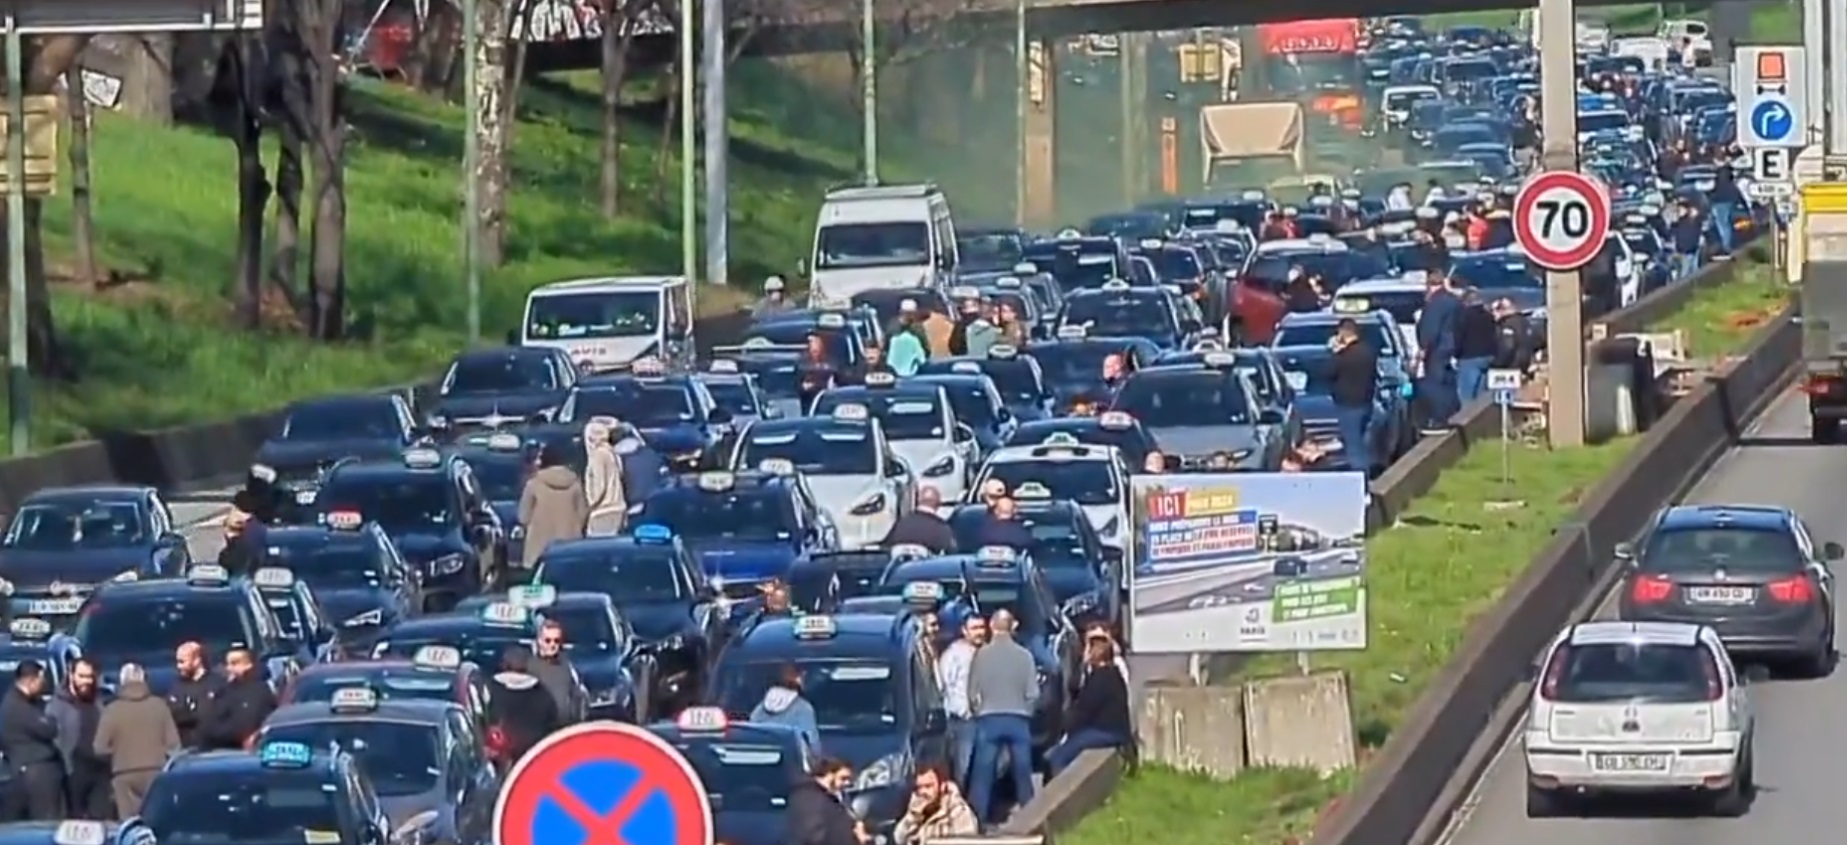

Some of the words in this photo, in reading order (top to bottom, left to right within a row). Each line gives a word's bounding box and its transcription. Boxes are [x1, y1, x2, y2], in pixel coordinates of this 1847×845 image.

[1763, 150, 1781, 178] E
[1536, 201, 1588, 238] 70
[1158, 495, 1179, 516] ICI
